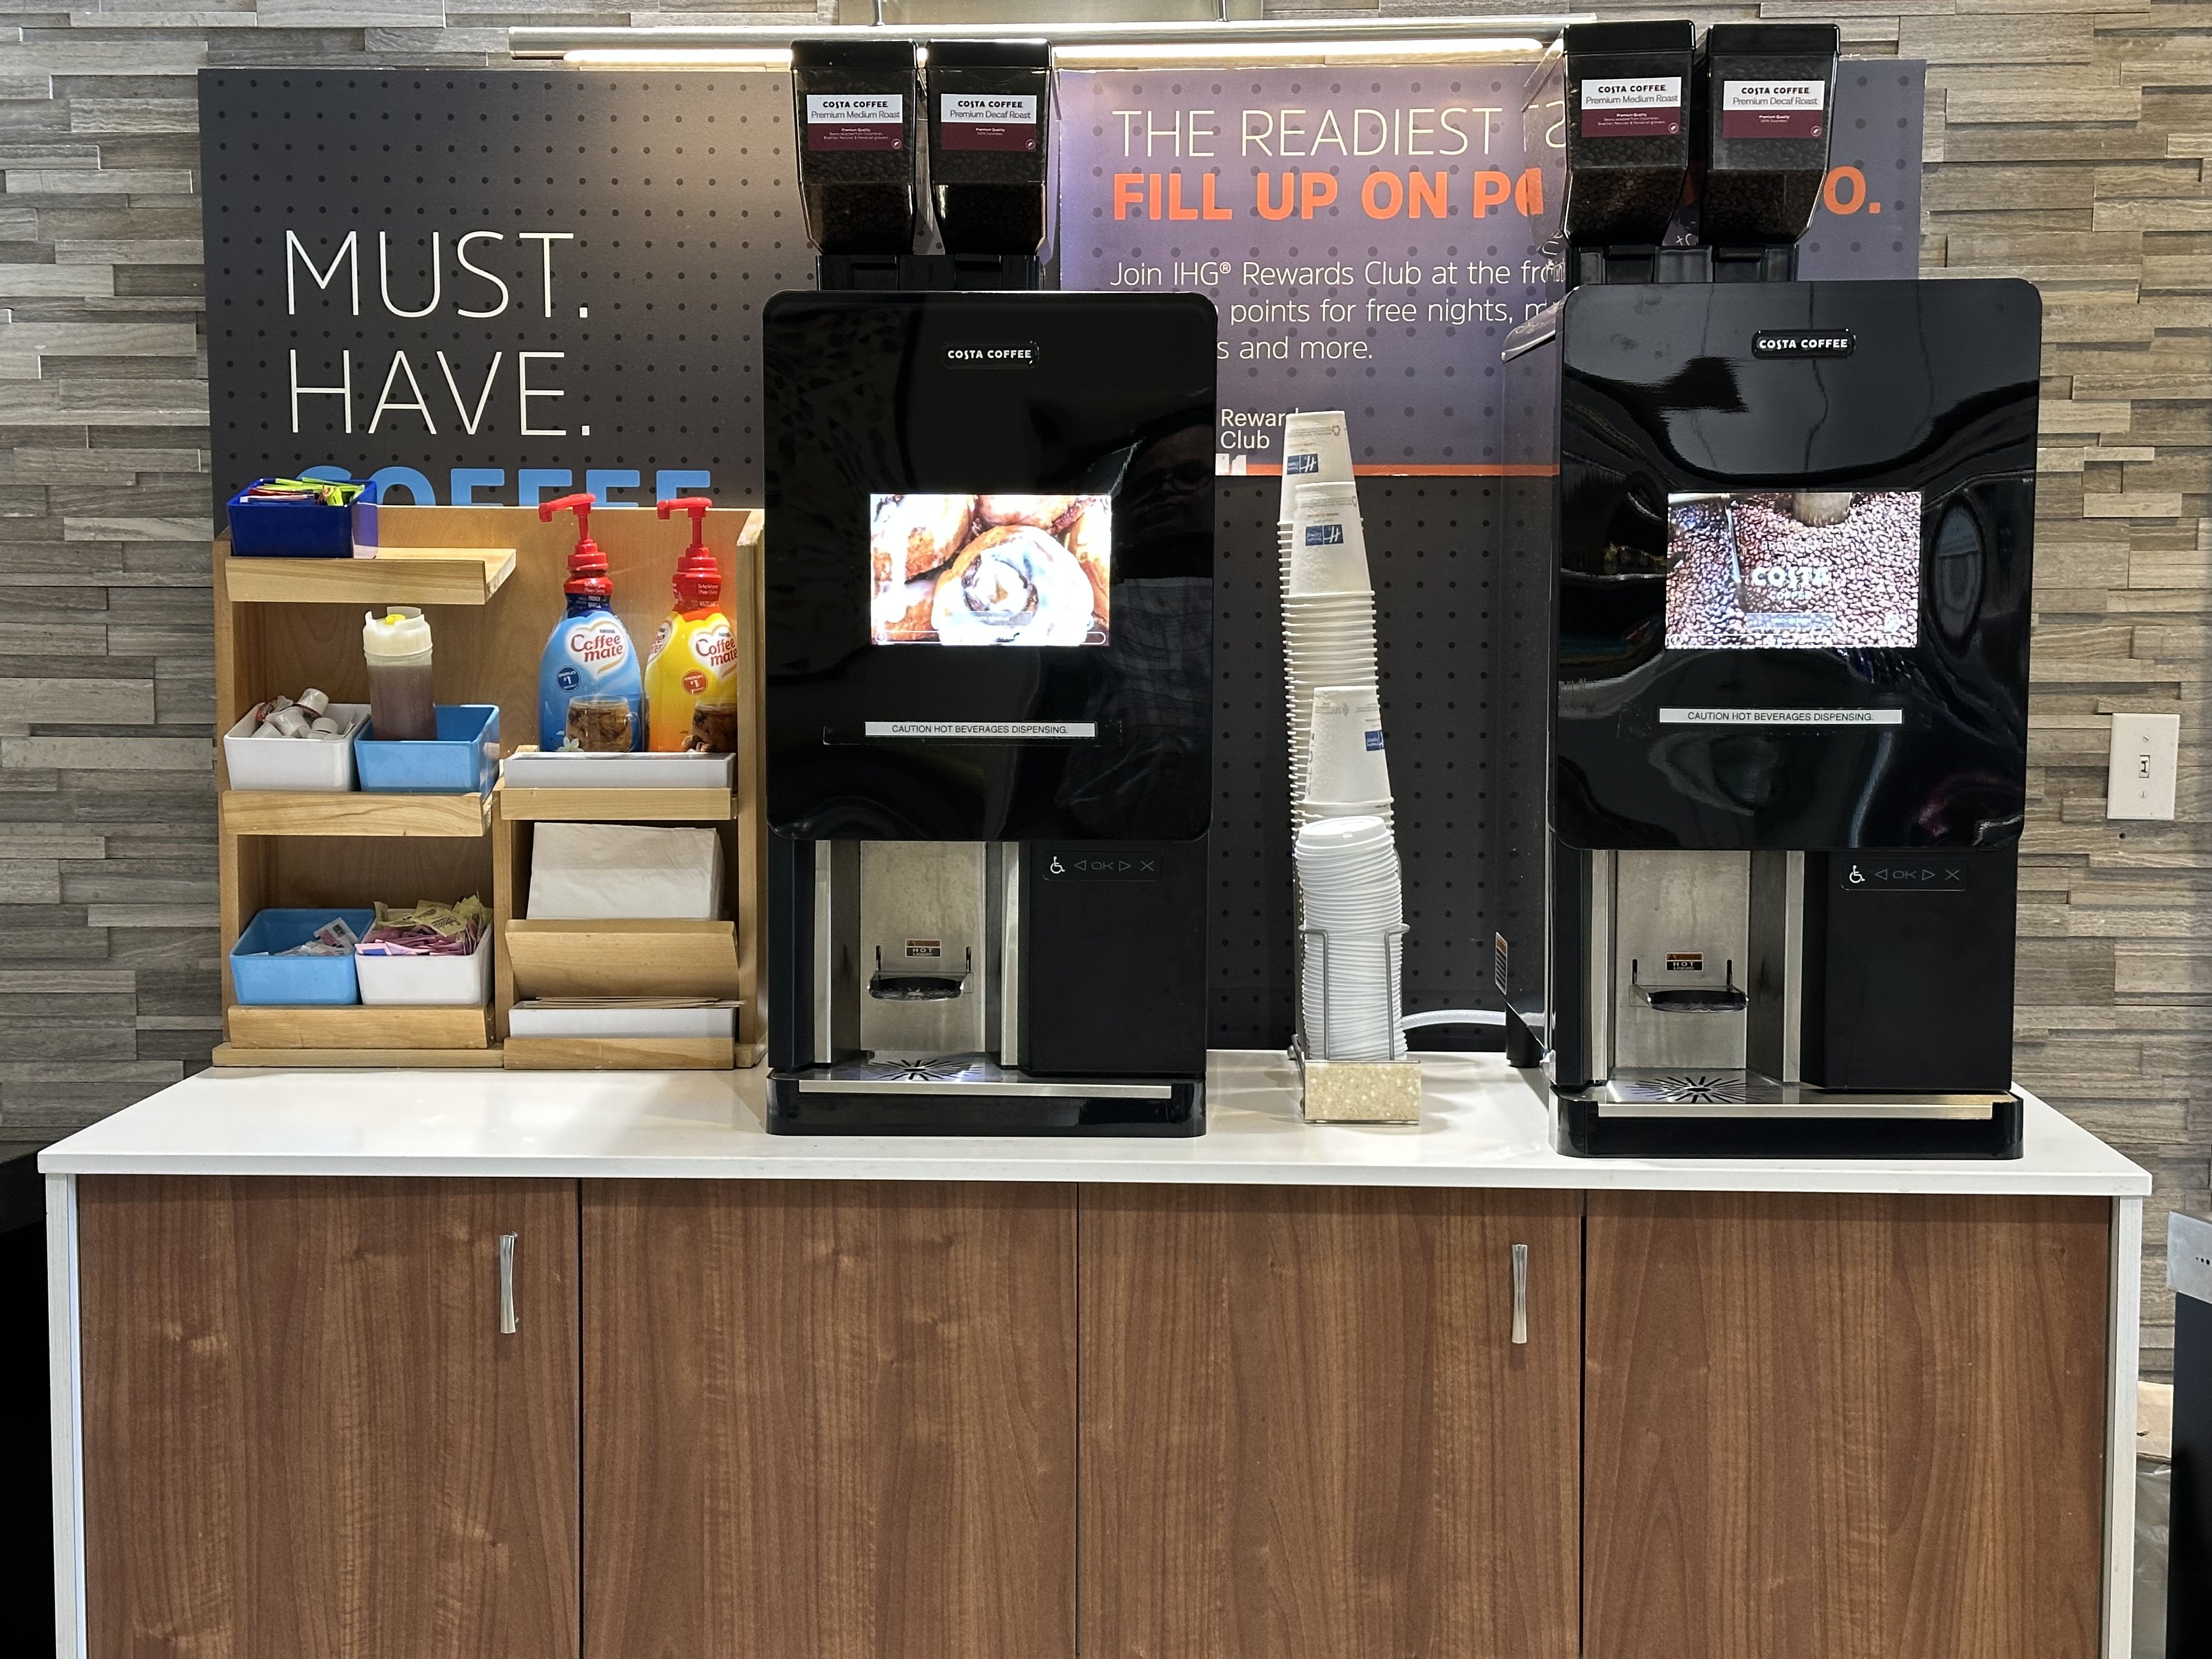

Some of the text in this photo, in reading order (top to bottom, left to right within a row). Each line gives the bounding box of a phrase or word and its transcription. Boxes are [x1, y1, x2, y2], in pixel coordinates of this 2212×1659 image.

[1586, 96, 1621, 104] Premium
[1622, 95, 1654, 103] Medium
[1770, 97, 1794, 105] Decaf
[950, 110, 984, 118] Premium
[1112, 110, 1215, 157] THE
[1242, 108, 1503, 156] READIEST
[1114, 173, 1232, 220] FILL
[1257, 172, 1339, 220] UP
[1362, 171, 1447, 219] ON
[286, 230, 588, 318] MUST.
[1110, 262, 1162, 286] Join
[1243, 261, 1354, 285] Rewards
[1364, 261, 1422, 285] Club
[1431, 262, 1458, 284] at
[1467, 261, 1511, 284] the
[1231, 299, 1311, 326] points
[1321, 298, 1356, 321] for
[1365, 298, 1417, 321] free
[1428, 298, 1513, 325] nights,
[1239, 336, 1288, 359] and
[1300, 340, 1373, 359] more.
[1759, 339, 1848, 349] COSTA COFFEE
[947, 350, 1031, 360] COSTA COFFEE
[290, 349, 590, 436] HAVE.
[1221, 430, 1270, 449] Club
[1752, 566, 1830, 589] COSTA
[570, 634, 620, 652] Coffee
[695, 638, 736, 657] Coffee
[584, 644, 623, 663] mate
[710, 648, 737, 667] mate
[1688, 712, 1874, 721] CAUTION HOT BEVERAGES DISPENSING.
[891, 724, 932, 733] CAUTION
[934, 725, 952, 733] HOT
[955, 725, 1009, 733] BEVERAGES
[1091, 861, 1114, 870] OK
[1893, 870, 1916, 879] OK
